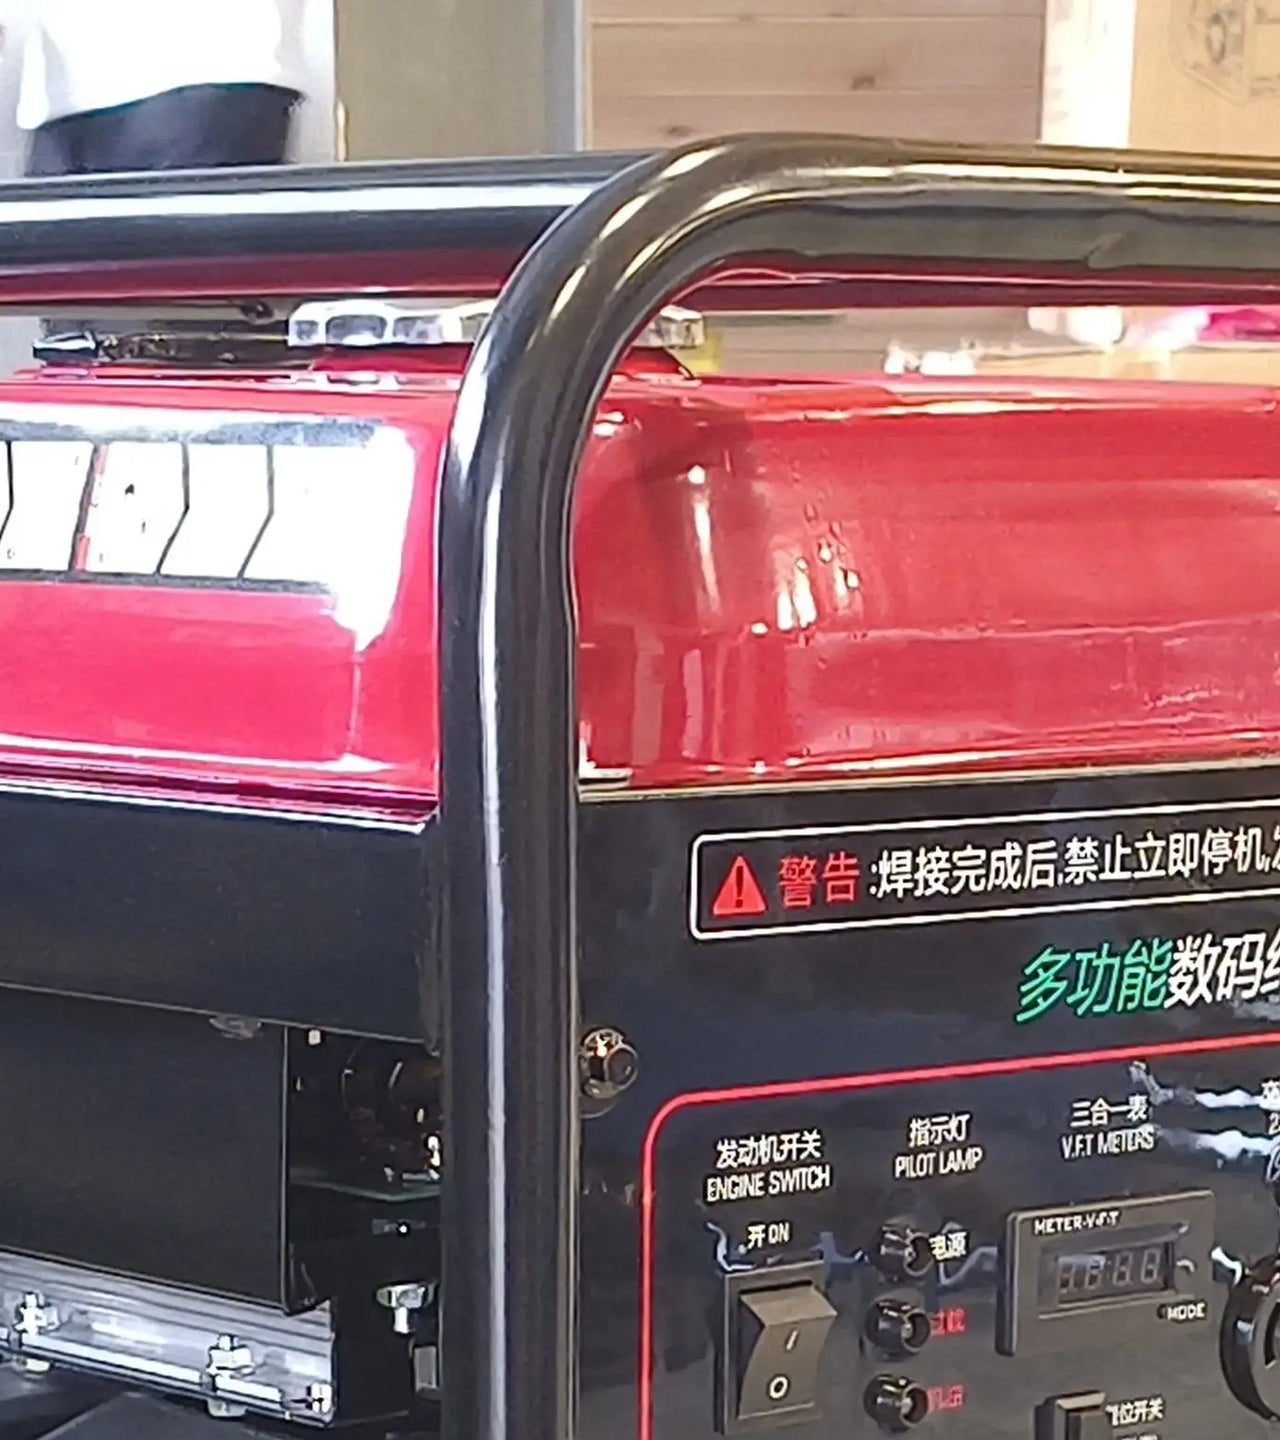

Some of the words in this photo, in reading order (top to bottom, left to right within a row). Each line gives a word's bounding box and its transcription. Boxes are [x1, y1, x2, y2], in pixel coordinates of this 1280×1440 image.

[1070, 1096, 1149, 1128] 三合一表
[908, 1113, 971, 1148] 指示灯
[716, 1129, 822, 1167] 发动机开关
[894, 1150, 936, 1179] PILOT
[938, 1147, 983, 1175] LAMP
[706, 1173, 765, 1202] ENGINE
[768, 1164, 832, 1195] SWITCH
[746, 1224, 766, 1249] 开
[768, 1222, 790, 1244] ON
[1166, 1302, 1206, 1321] MODE
